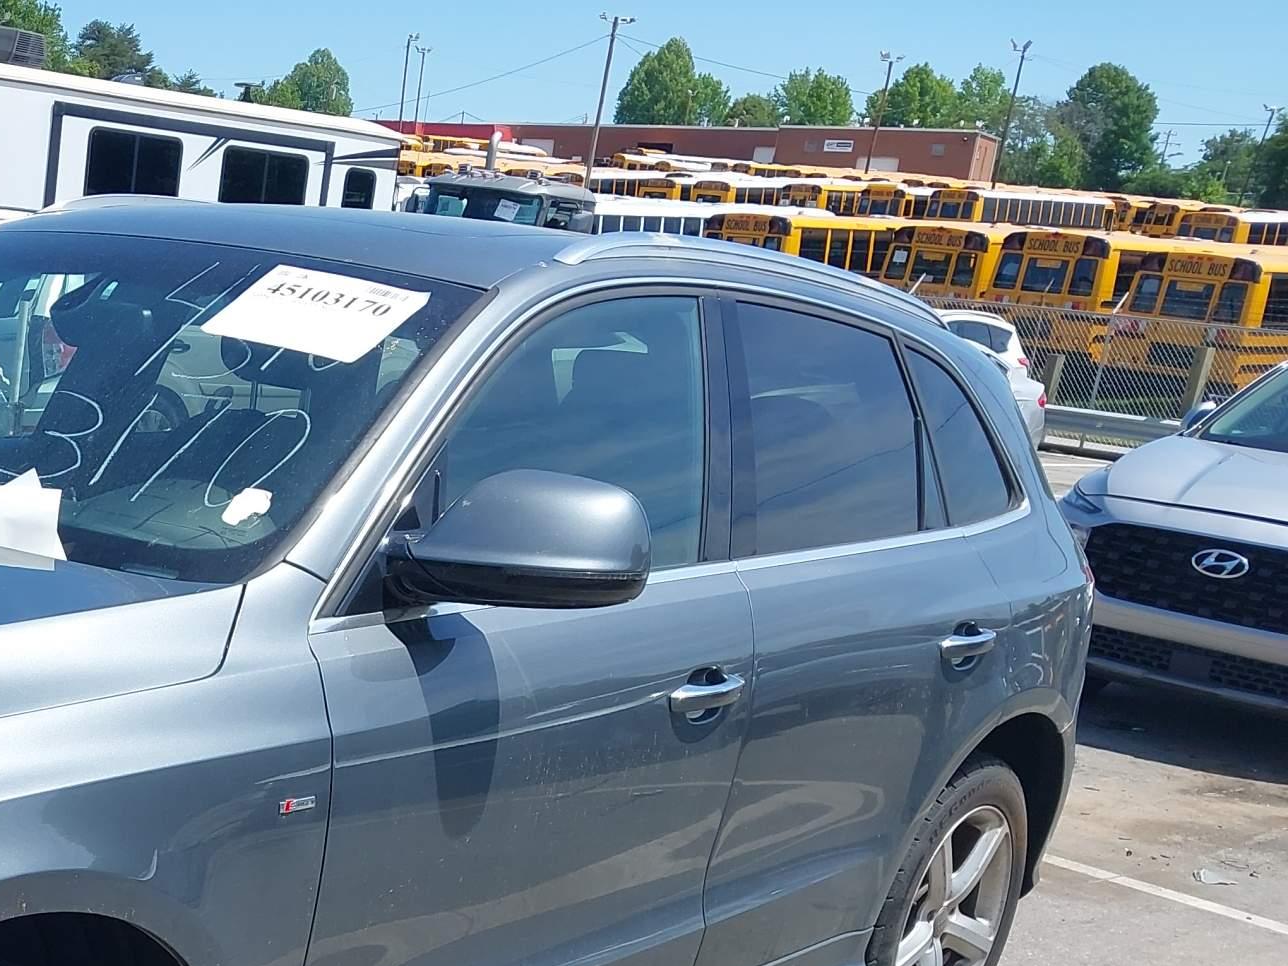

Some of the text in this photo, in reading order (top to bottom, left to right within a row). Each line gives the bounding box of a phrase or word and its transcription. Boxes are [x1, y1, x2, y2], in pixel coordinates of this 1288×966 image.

[725, 219, 768, 232] SCHOOL BUS
[916, 231, 963, 247] SCHOOL BUS
[1026, 237, 1081, 253] SCHOOL BUS
[1167, 259, 1228, 277] SCHOOL BUS
[267, 282, 392, 316] 45103170
